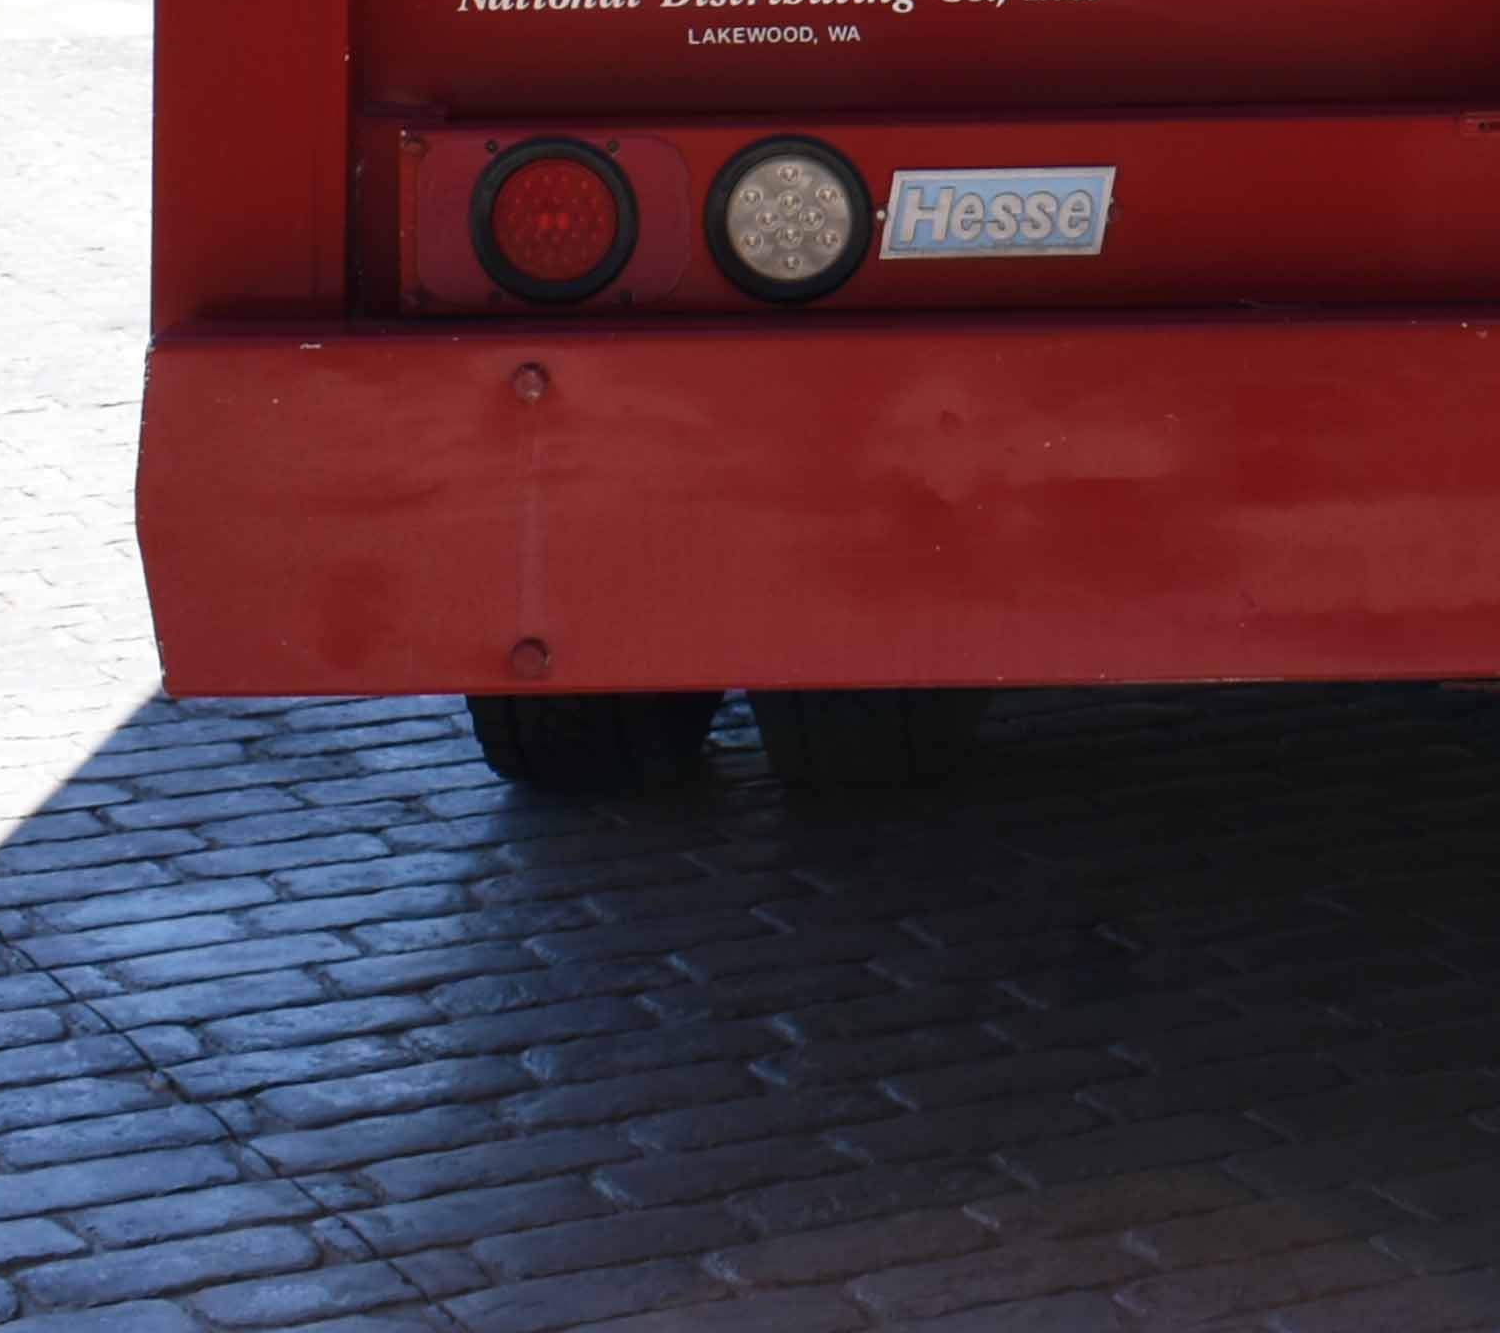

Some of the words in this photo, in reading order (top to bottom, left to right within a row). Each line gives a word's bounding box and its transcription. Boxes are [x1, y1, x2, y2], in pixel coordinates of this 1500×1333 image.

[687, 25, 818, 45] LAKEWOOD,
[828, 24, 861, 43] WA
[899, 185, 1093, 243] Hesse
